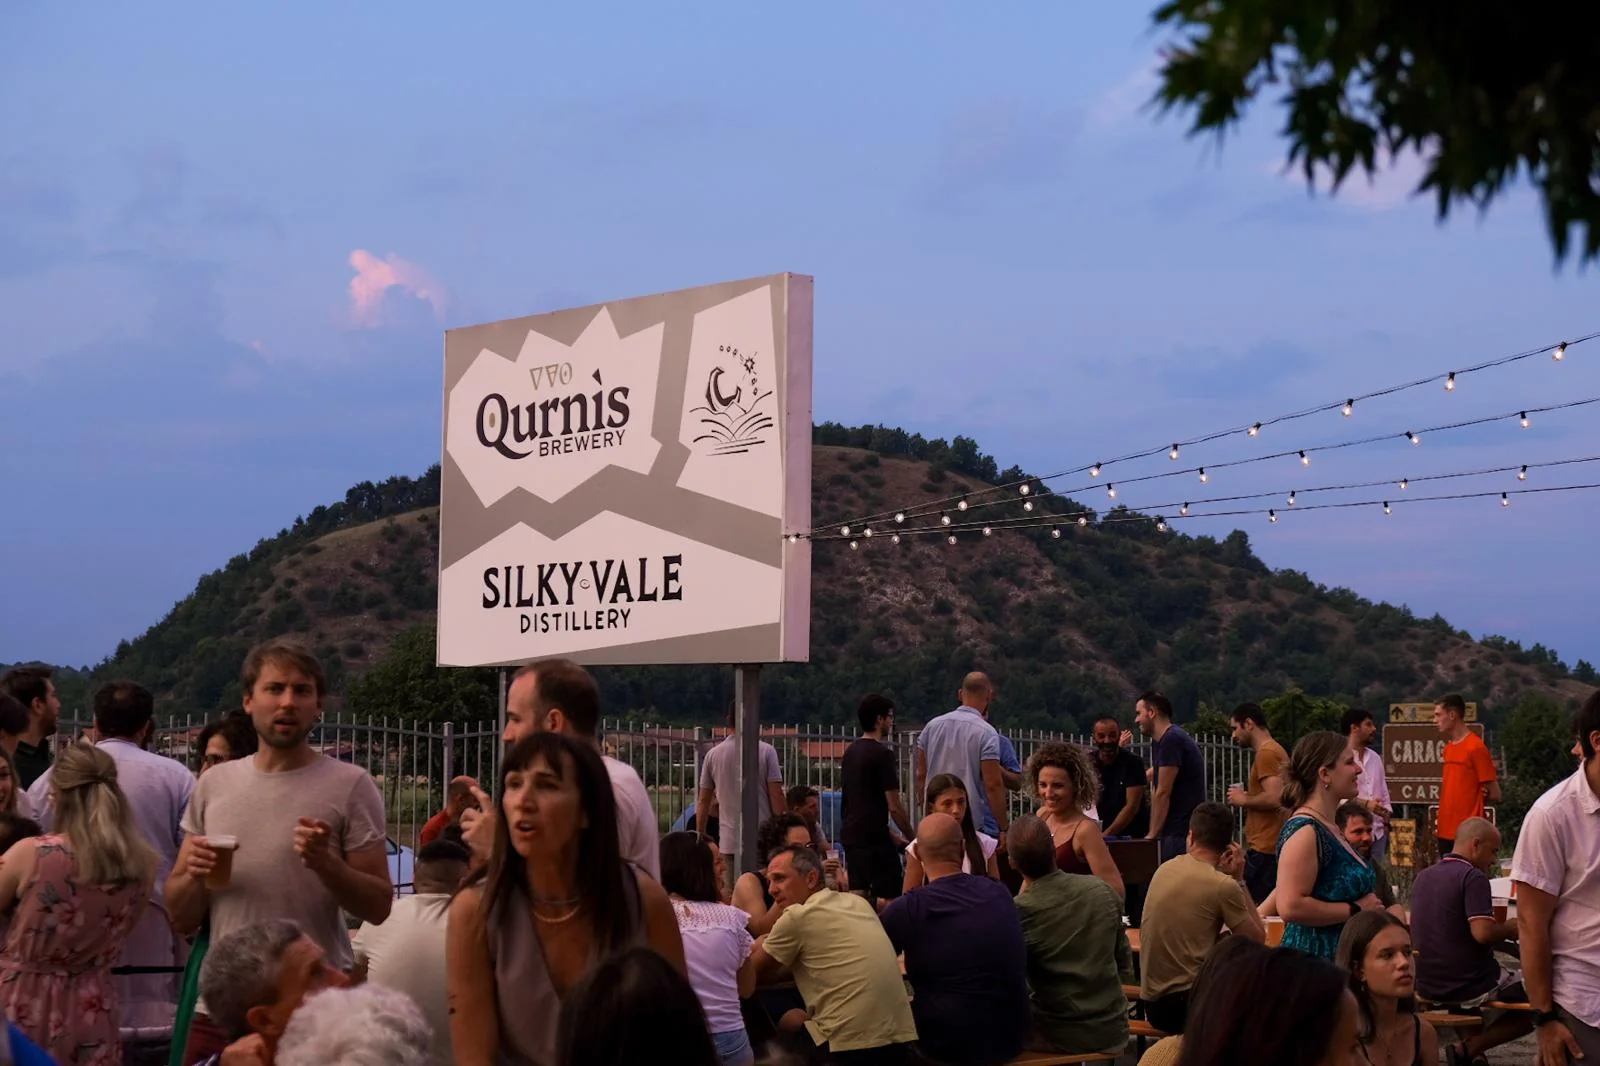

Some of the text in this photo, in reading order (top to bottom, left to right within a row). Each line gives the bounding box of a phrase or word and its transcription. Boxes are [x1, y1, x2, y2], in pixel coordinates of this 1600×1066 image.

[539, 429, 626, 457] BREWERY
[482, 553, 683, 609] SILKY VALE
[520, 608, 631, 634] DISTILLERY
